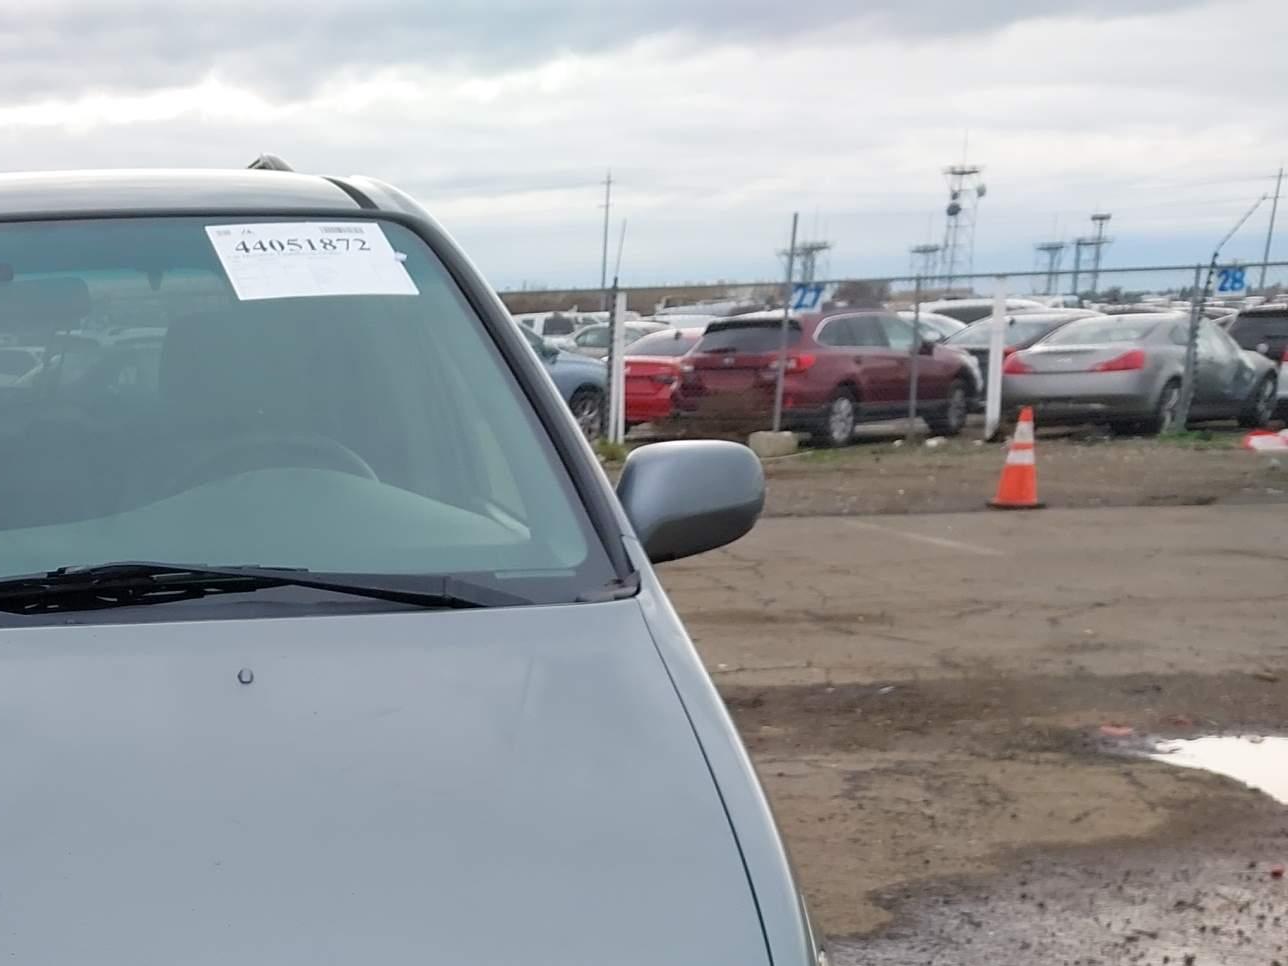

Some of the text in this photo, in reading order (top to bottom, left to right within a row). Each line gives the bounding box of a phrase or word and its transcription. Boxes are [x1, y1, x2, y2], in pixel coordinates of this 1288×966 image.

[235, 238, 371, 253] 44051872
[1216, 269, 1246, 291] 28
[793, 283, 824, 310] 27
